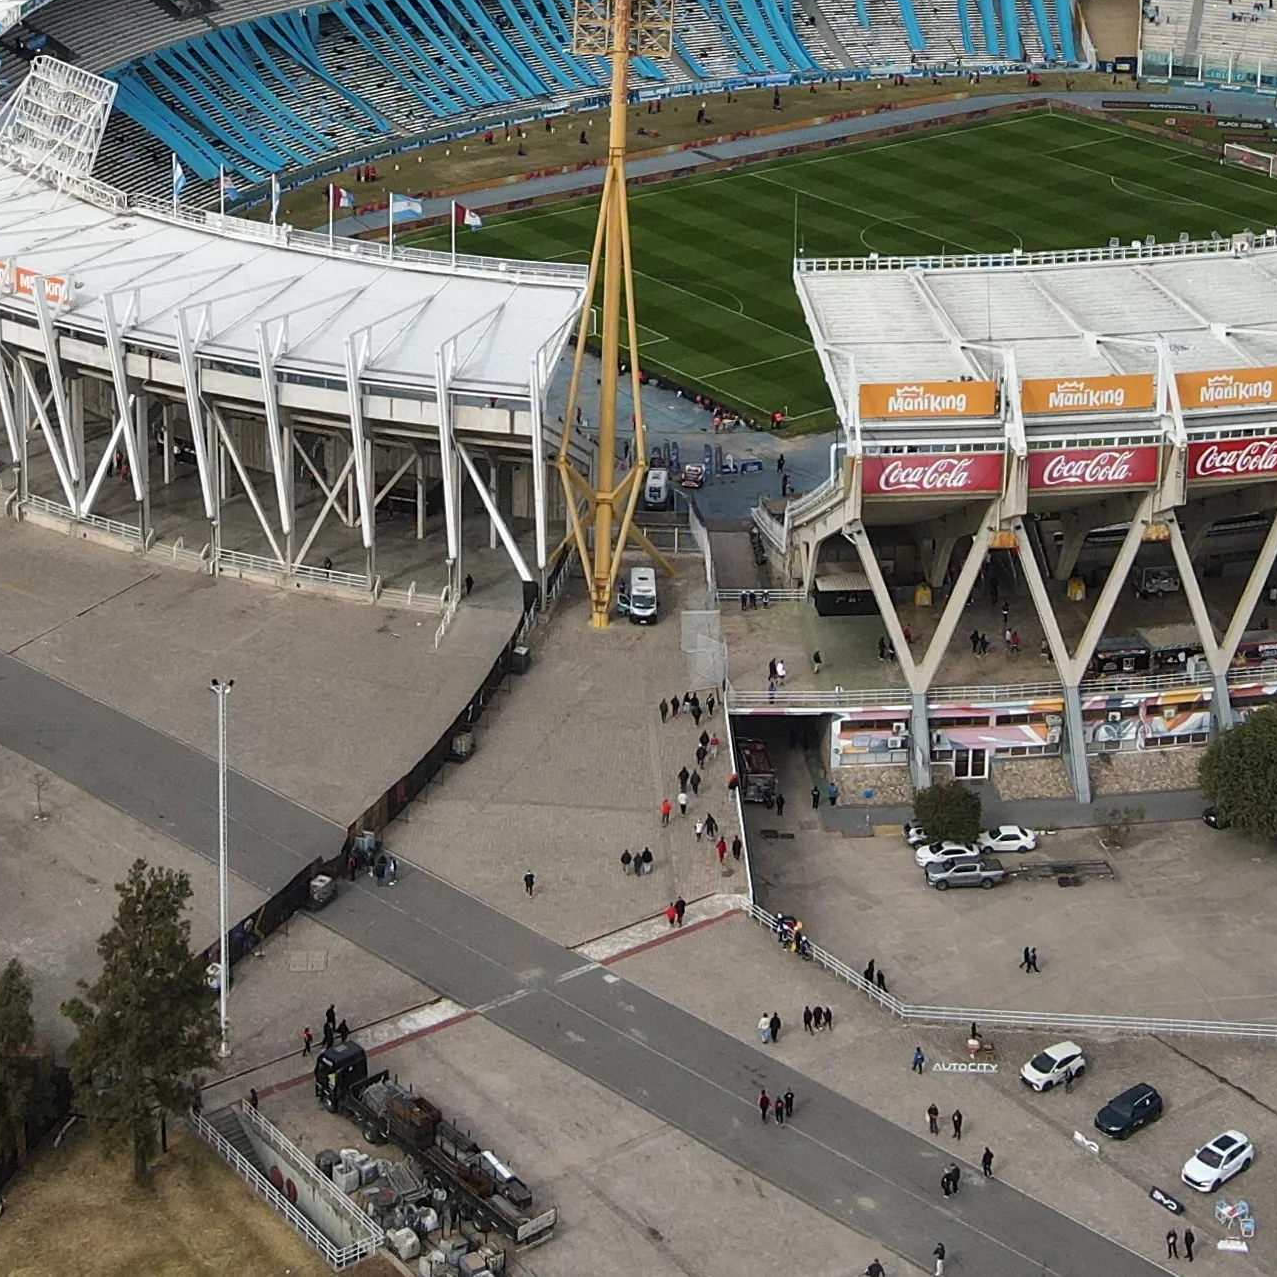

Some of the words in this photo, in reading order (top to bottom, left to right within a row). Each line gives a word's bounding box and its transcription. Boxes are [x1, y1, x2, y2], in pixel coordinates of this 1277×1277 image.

[879, 458, 973, 490] Coca-Cola
[1043, 451, 1135, 485] Coca-Cola
[932, 1062, 998, 1072] AUTOCITY
